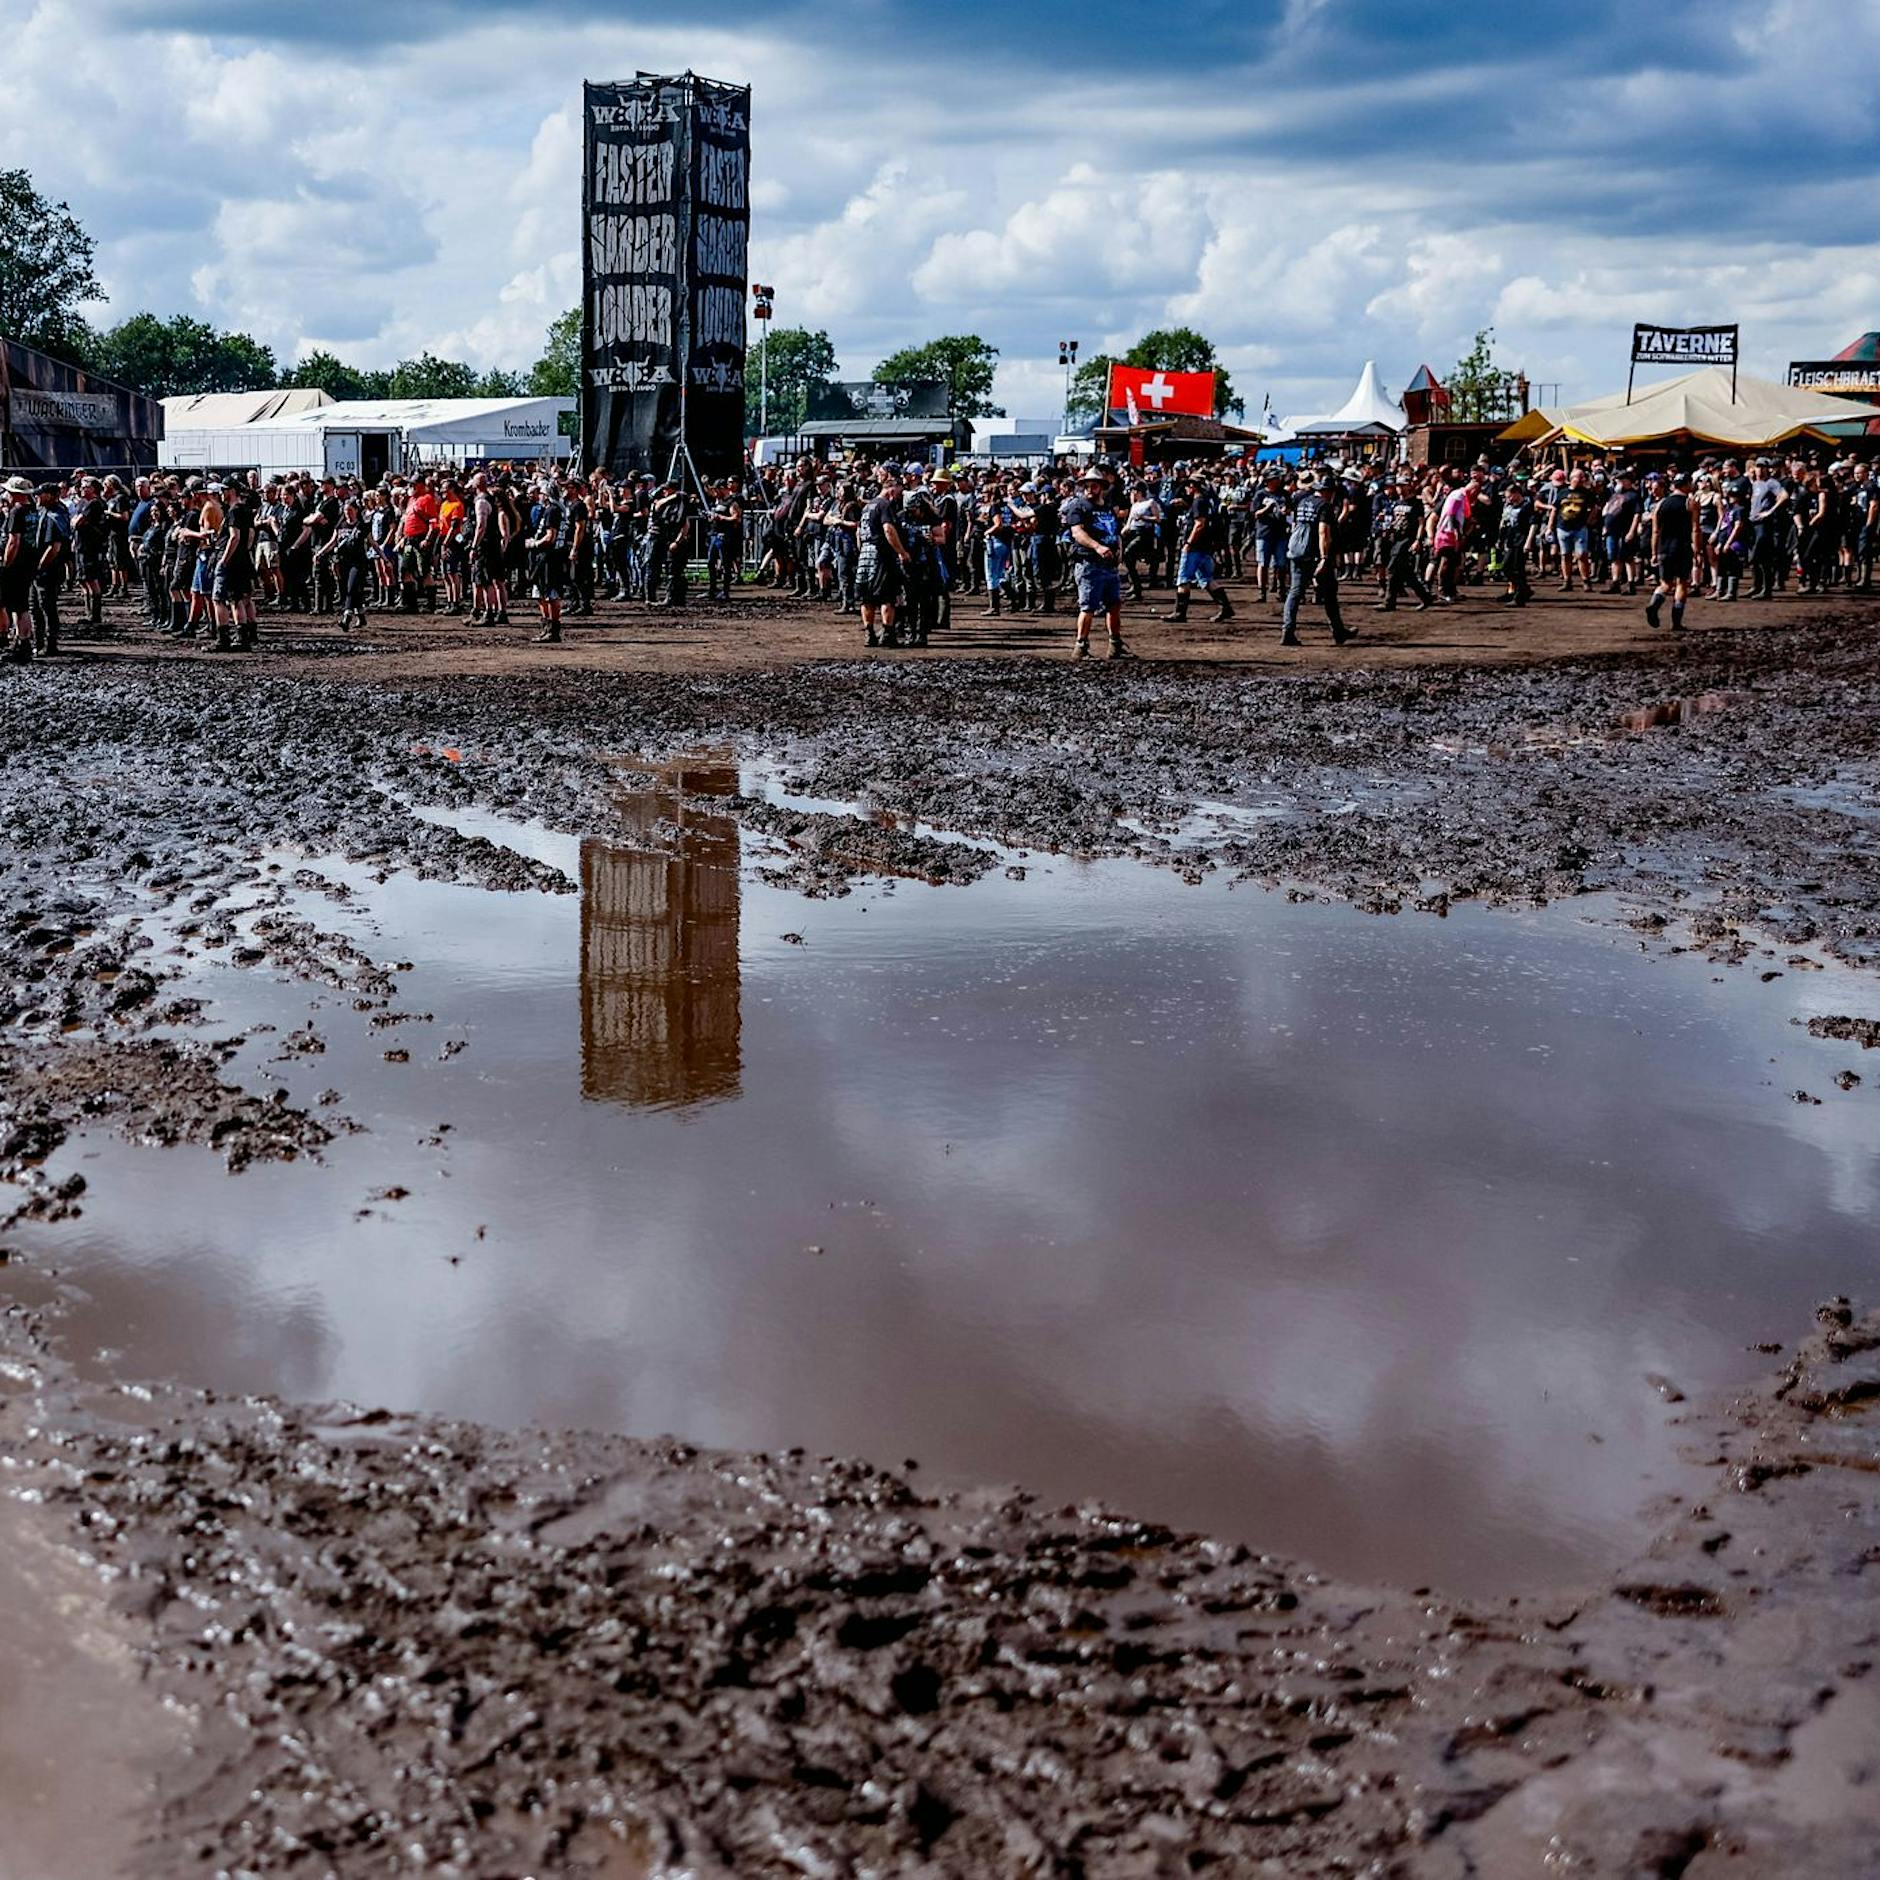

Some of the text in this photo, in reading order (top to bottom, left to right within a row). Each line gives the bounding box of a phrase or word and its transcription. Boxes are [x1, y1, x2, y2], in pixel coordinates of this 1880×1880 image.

[595, 140, 674, 204] FASTER
[701, 140, 745, 209] FASTER
[591, 213, 676, 278] HARDER
[697, 213, 745, 281] HARDER
[592, 284, 672, 351] LOUDER
[697, 285, 743, 351] LOUDER
[1636, 331, 1735, 354] TAVERNE
[28, 399, 97, 419] WACKINGER
[504, 419, 551, 437] Krombacher
[335, 461, 345, 471] FC
